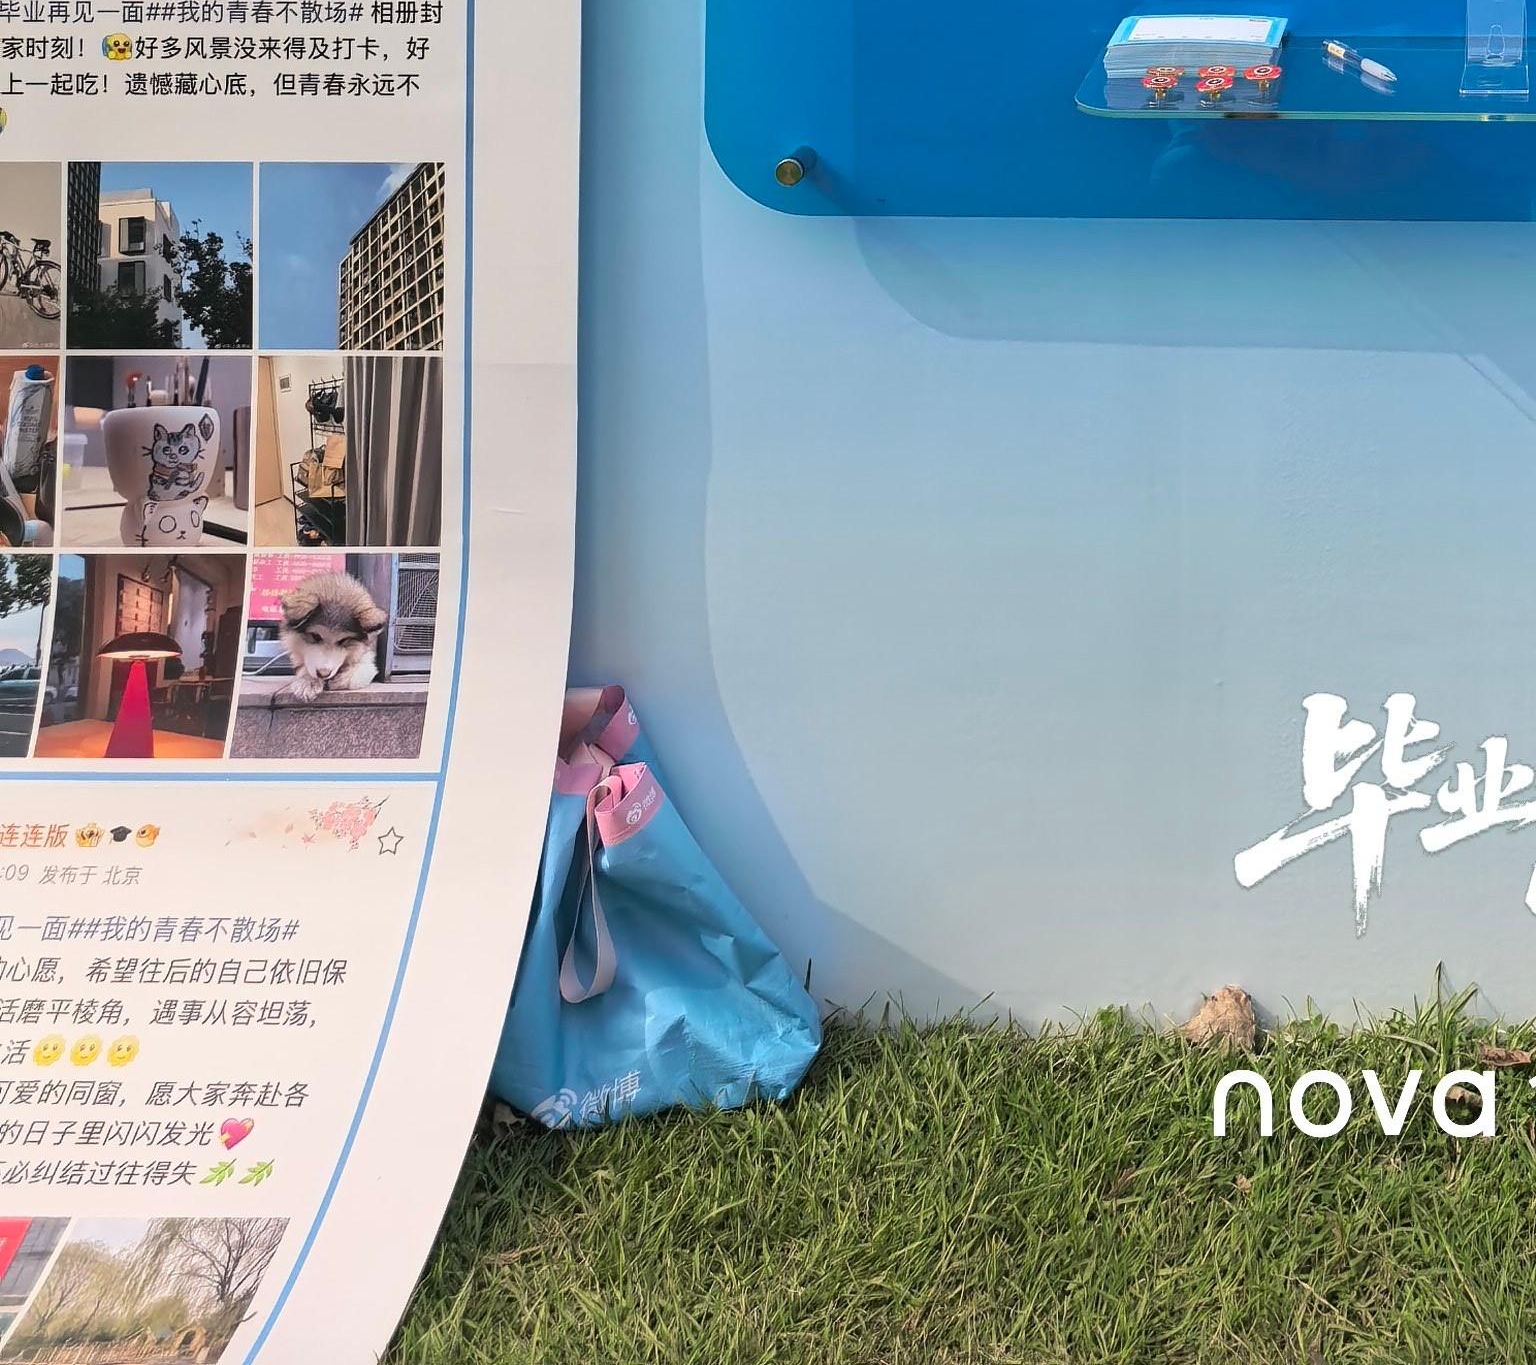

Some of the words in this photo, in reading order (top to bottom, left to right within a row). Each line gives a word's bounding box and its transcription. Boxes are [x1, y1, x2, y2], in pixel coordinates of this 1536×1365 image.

[371, 0, 443, 24] 相册封
[0, 36, 80, 60] 家时刻！
[136, 36, 429, 61] 好多风景没来得及打卡，好
[0, 72, 419, 96] 上一起吃！遗憾藏心底，但青春永远不
[39, 866, 97, 885] 发布于
[103, 866, 142, 885] 北京
[0, 956, 347, 985] 心愿，希望往后的自己依旧保
[0, 1120, 214, 1146] 的日子里闪闪发光
[0, 1160, 197, 1185] 必纠结过往得失
